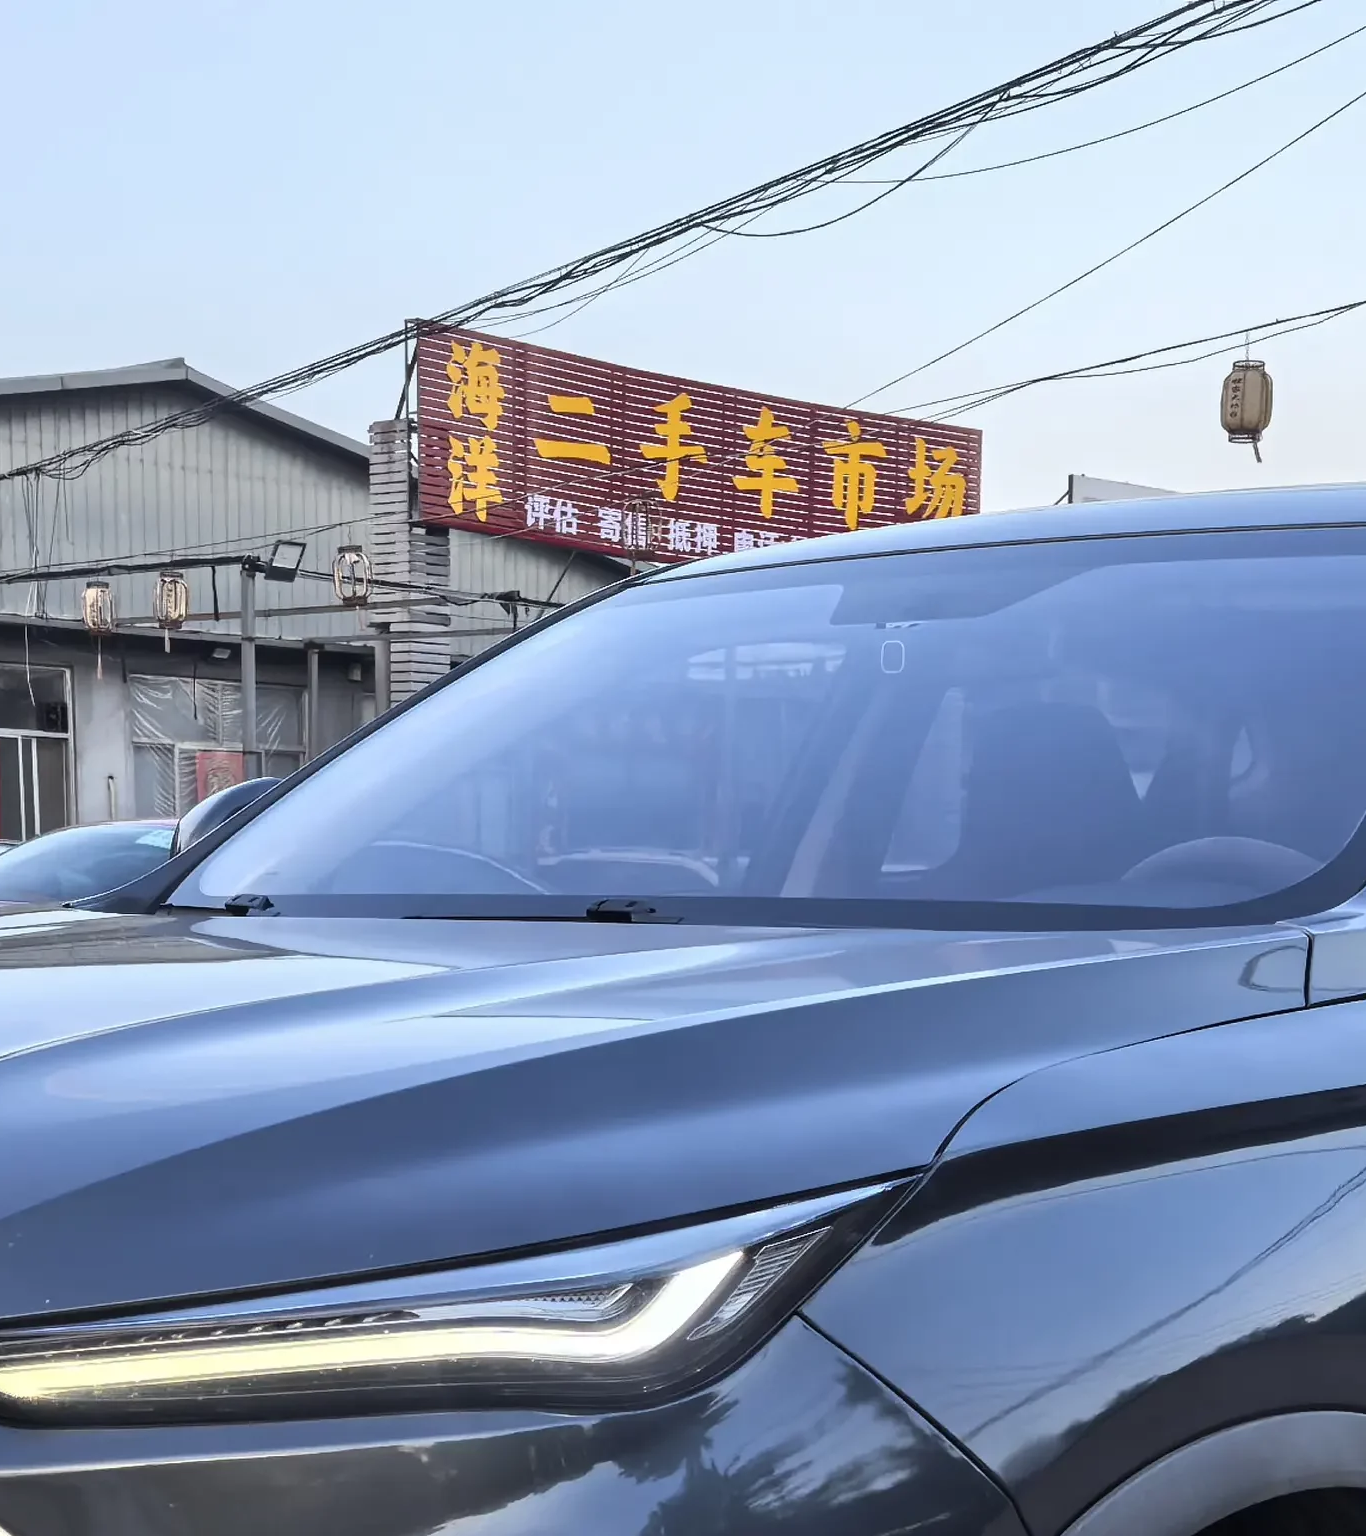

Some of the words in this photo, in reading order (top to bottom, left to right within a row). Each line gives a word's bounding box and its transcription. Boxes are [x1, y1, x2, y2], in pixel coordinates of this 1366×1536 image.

[446, 339, 506, 523] 海洋
[534, 392, 967, 531] 二手车市场
[524, 494, 579, 535] 评估
